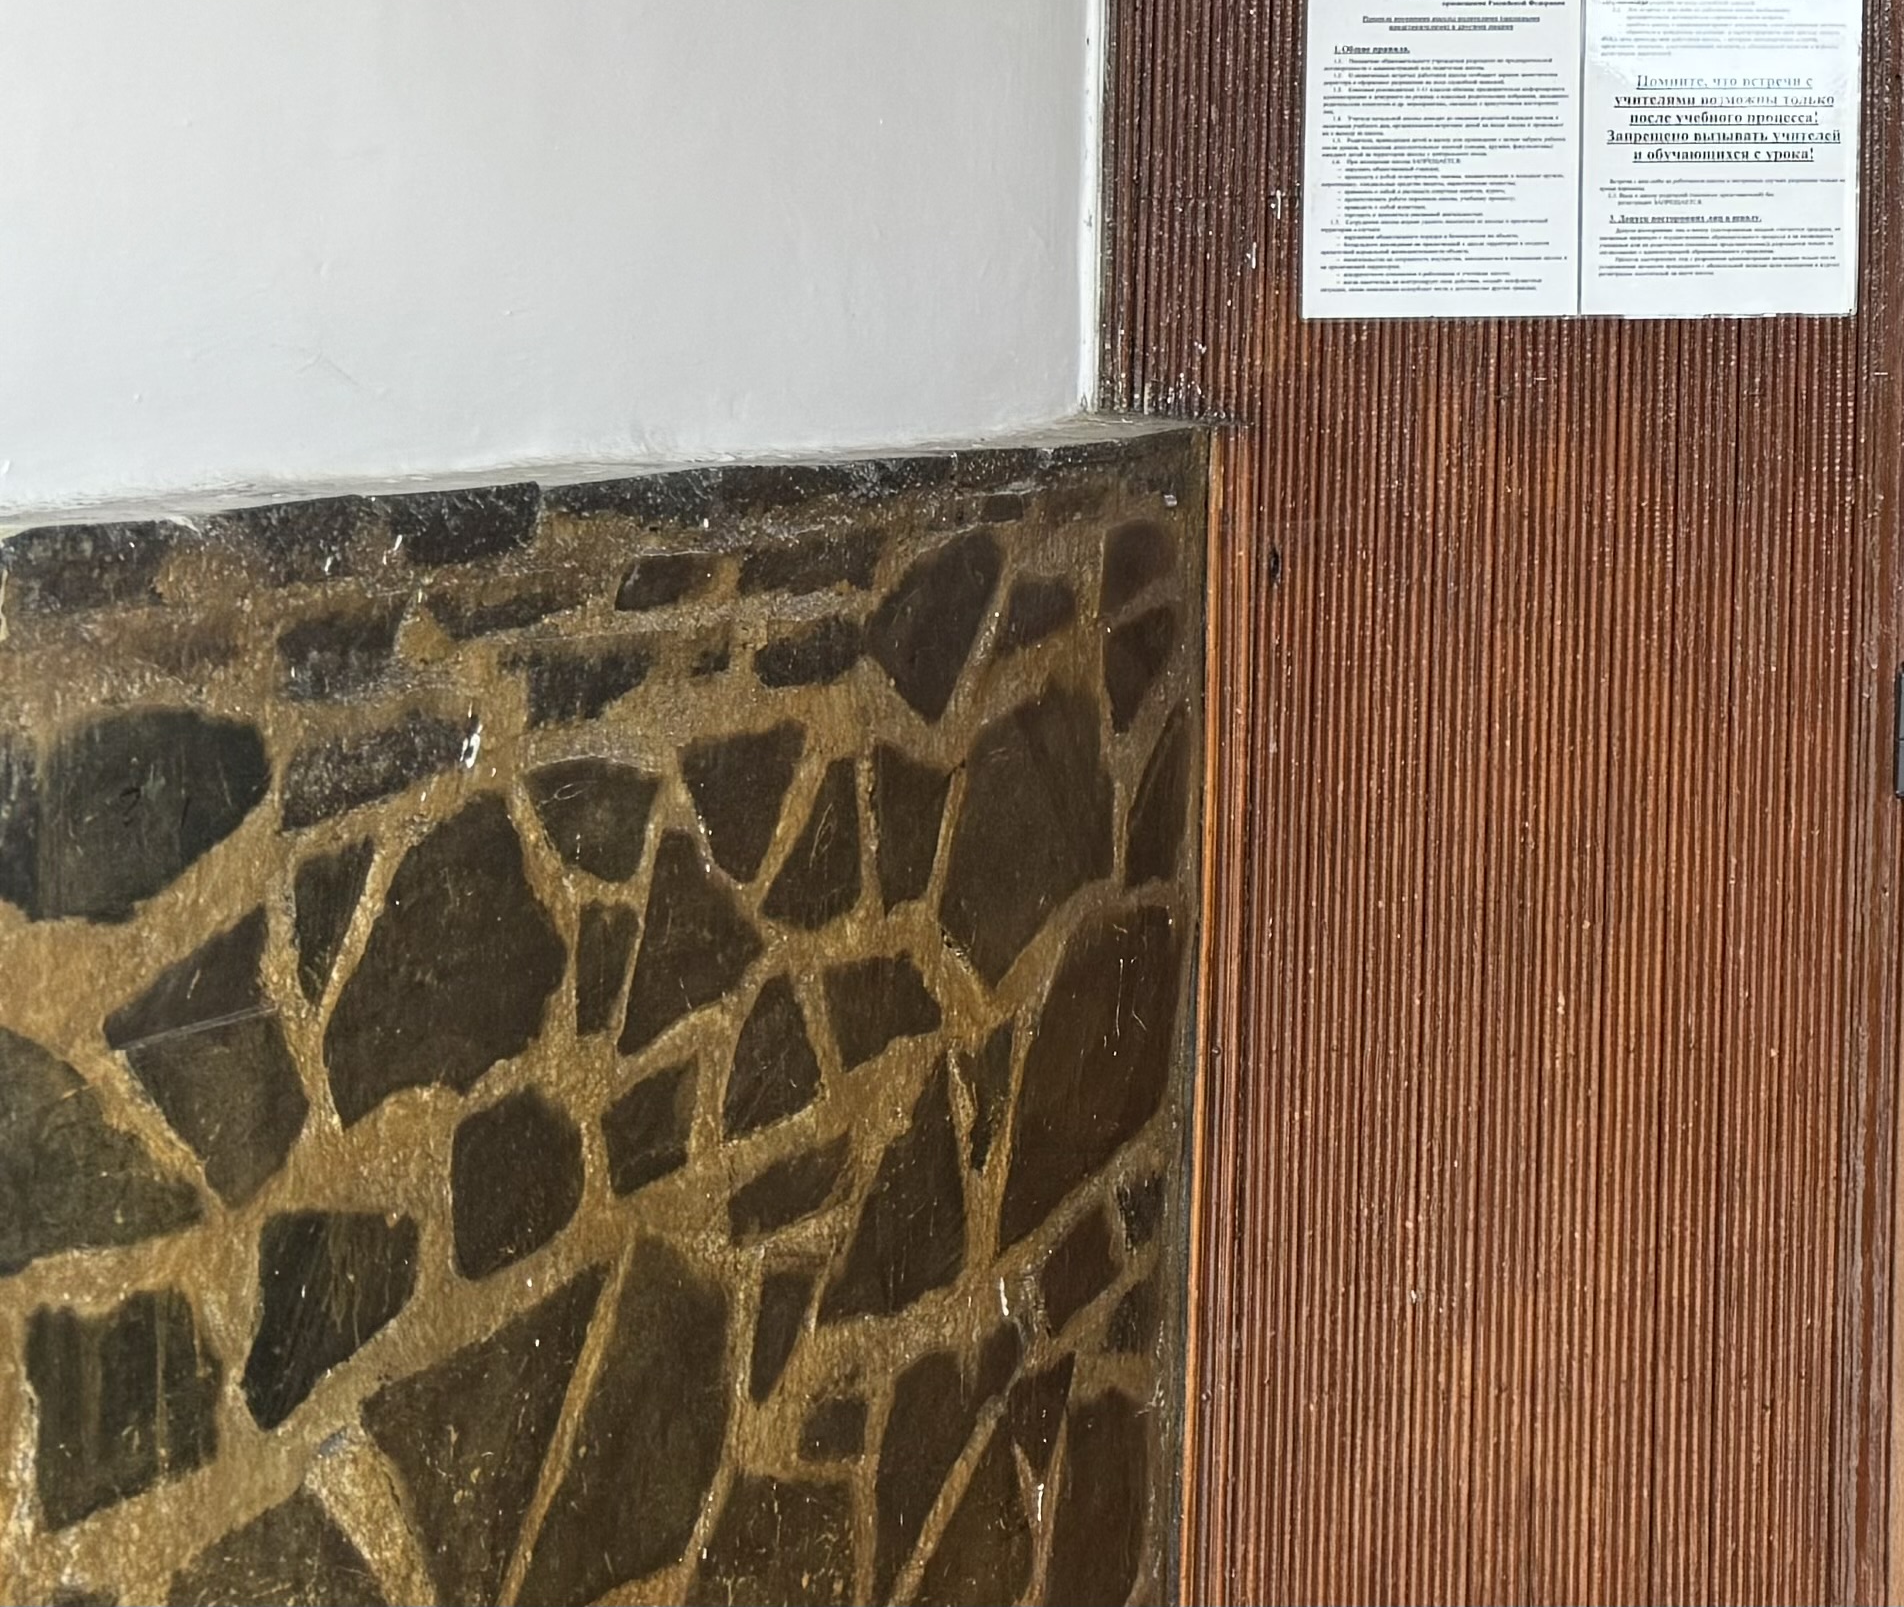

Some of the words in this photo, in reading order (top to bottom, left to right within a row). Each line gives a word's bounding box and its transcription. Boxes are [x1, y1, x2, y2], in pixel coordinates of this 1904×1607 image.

[1637, 75, 1708, 88] Помните,
[1713, 78, 1737, 86] что
[1743, 78, 1800, 88] встречи
[1806, 78, 1813, 86] с
[1614, 96, 1695, 107] учителями
[1701, 96, 1777, 105] возможны
[1783, 96, 1834, 105] только
[1630, 114, 1671, 123] после
[1676, 111, 1742, 125] учебного
[1747, 111, 1817, 125] процесса!
[1607, 129, 1688, 144] Запрещено
[1694, 132, 1767, 141] вызывать
[1773, 130, 1840, 143] учителей
[1634, 151, 1642, 160] и
[1647, 148, 1749, 161] обучающихся
[1754, 151, 1761, 159] с
[1766, 147, 1813, 161] урока!
